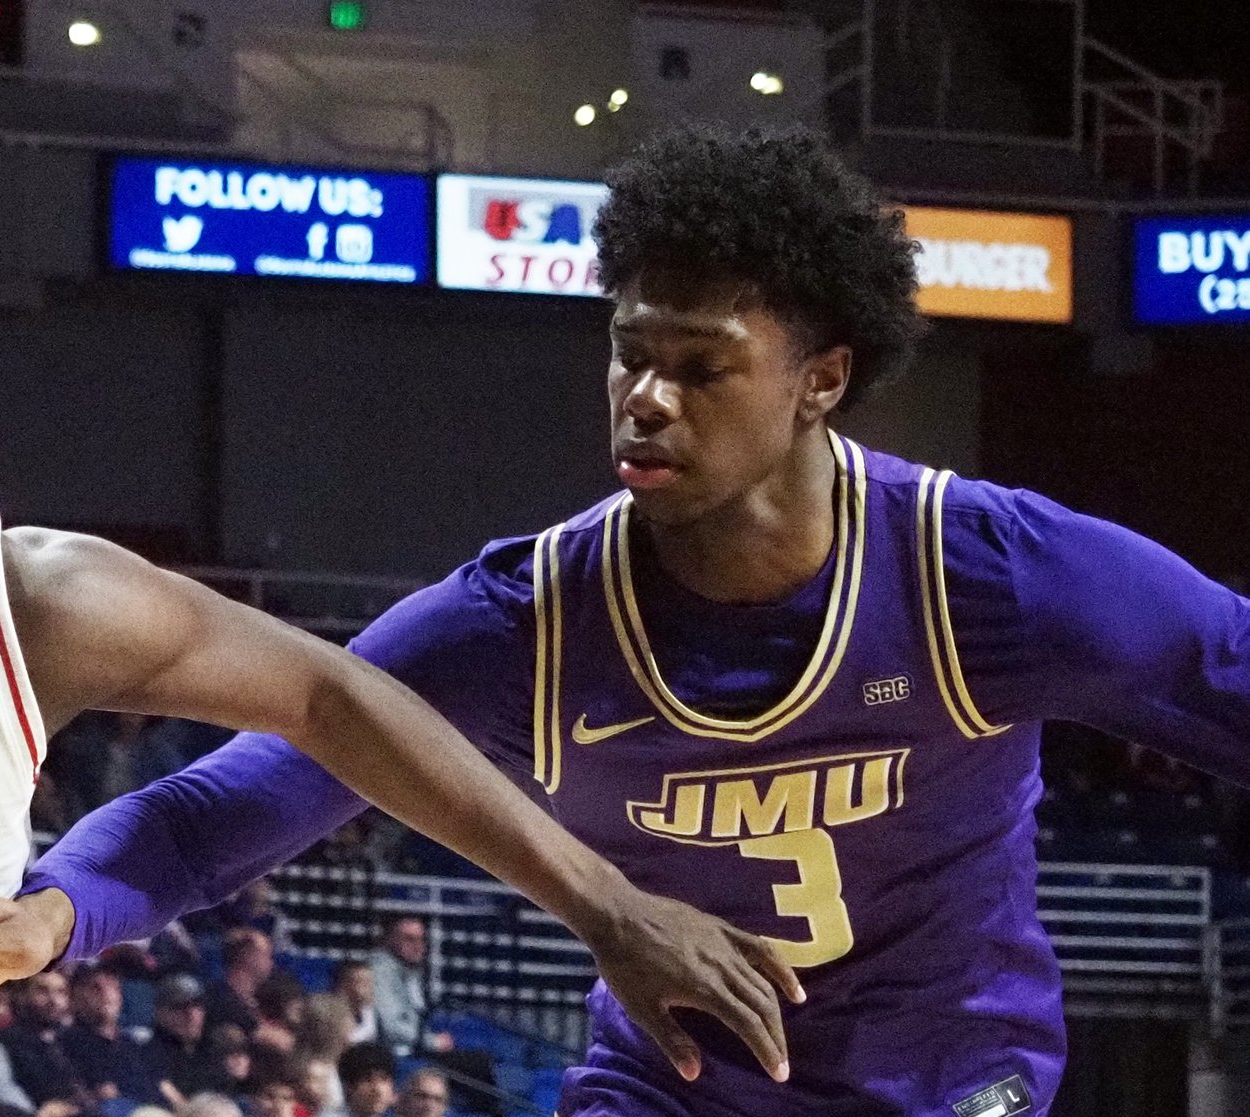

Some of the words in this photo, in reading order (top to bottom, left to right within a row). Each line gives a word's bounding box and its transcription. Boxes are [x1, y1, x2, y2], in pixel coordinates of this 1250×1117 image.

[154, 166, 317, 213] FOLLOW
[318, 176, 384, 218] US:
[1158, 229, 1250, 274] BUY
[863, 676, 910, 706] SBC
[634, 754, 897, 840] JMU
[738, 828, 854, 968] 3
[1006, 1089, 1021, 1104] L
